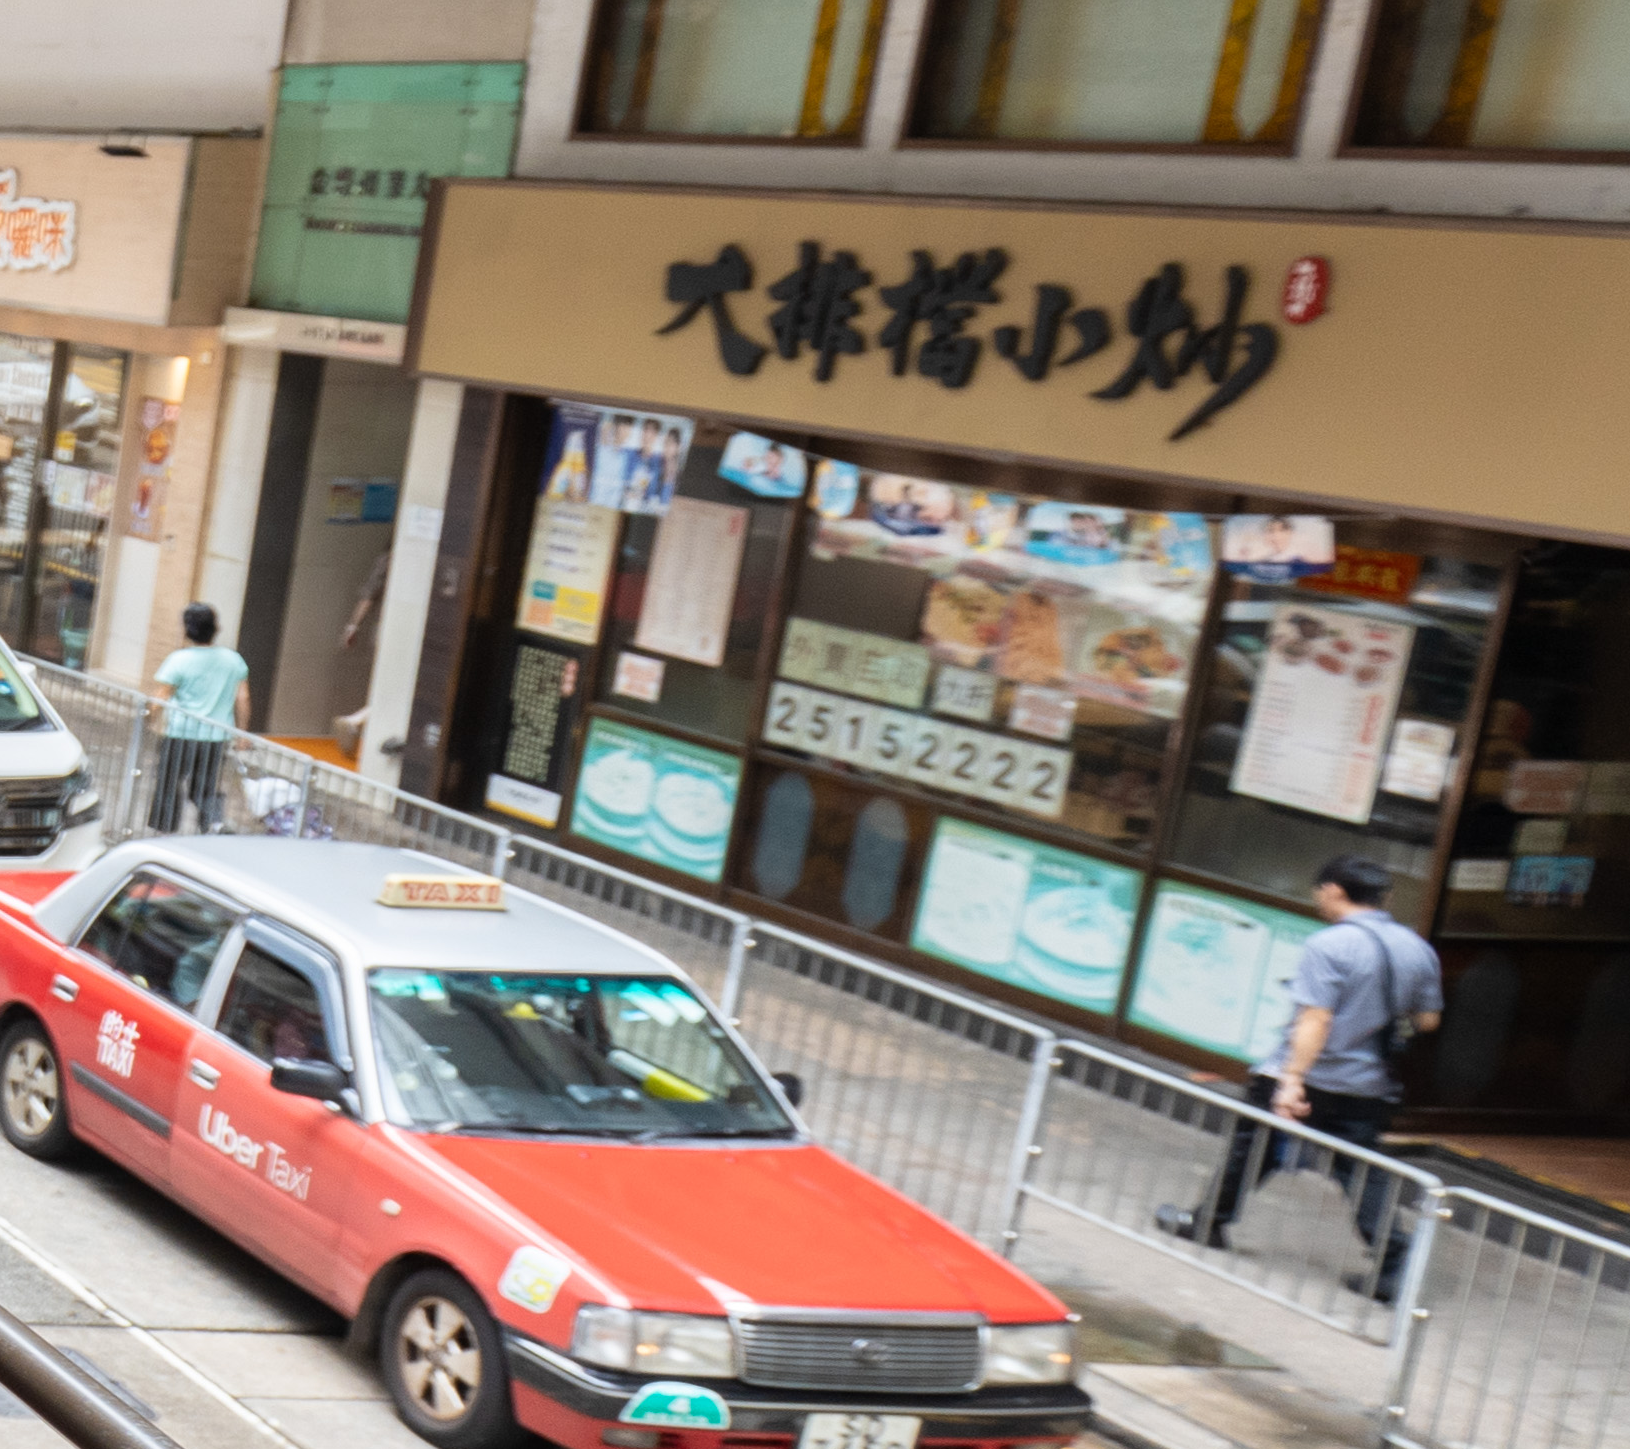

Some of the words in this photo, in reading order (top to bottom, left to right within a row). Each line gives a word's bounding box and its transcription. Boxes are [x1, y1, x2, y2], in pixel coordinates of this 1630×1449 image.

[656, 239, 1284, 445] 大排檔小炒
[775, 695, 1058, 801] 25152222
[403, 883, 501, 904] TAXI
[96, 1033, 135, 1078] TAXI
[99, 1009, 141, 1047] 的士
[198, 1104, 262, 1169] Uber
[264, 1140, 312, 1201] Taxi
